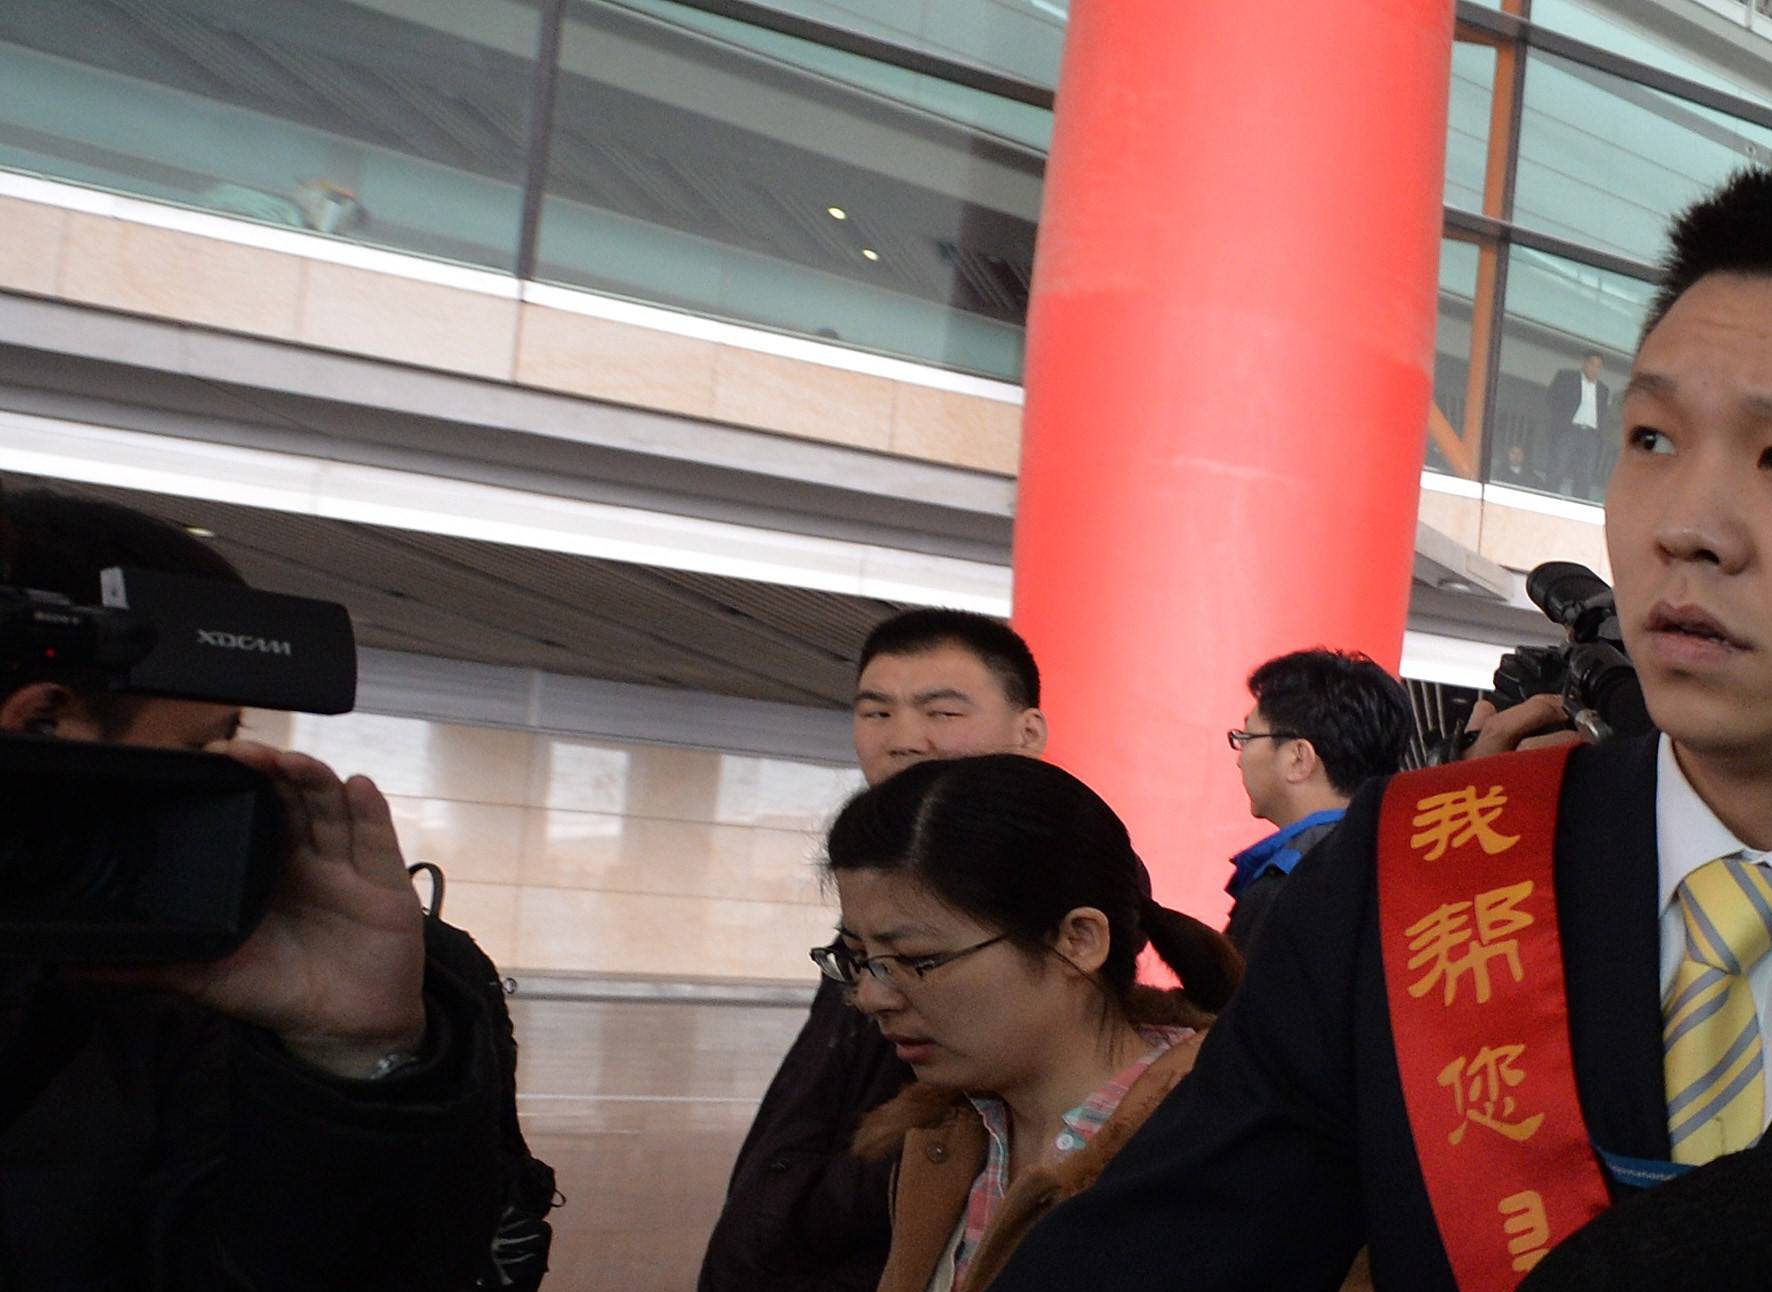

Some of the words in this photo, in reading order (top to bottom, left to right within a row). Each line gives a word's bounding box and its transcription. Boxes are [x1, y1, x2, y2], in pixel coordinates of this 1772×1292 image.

[196, 628, 292, 656] XDCAM
[1404, 785, 1545, 1146] 我帮您
